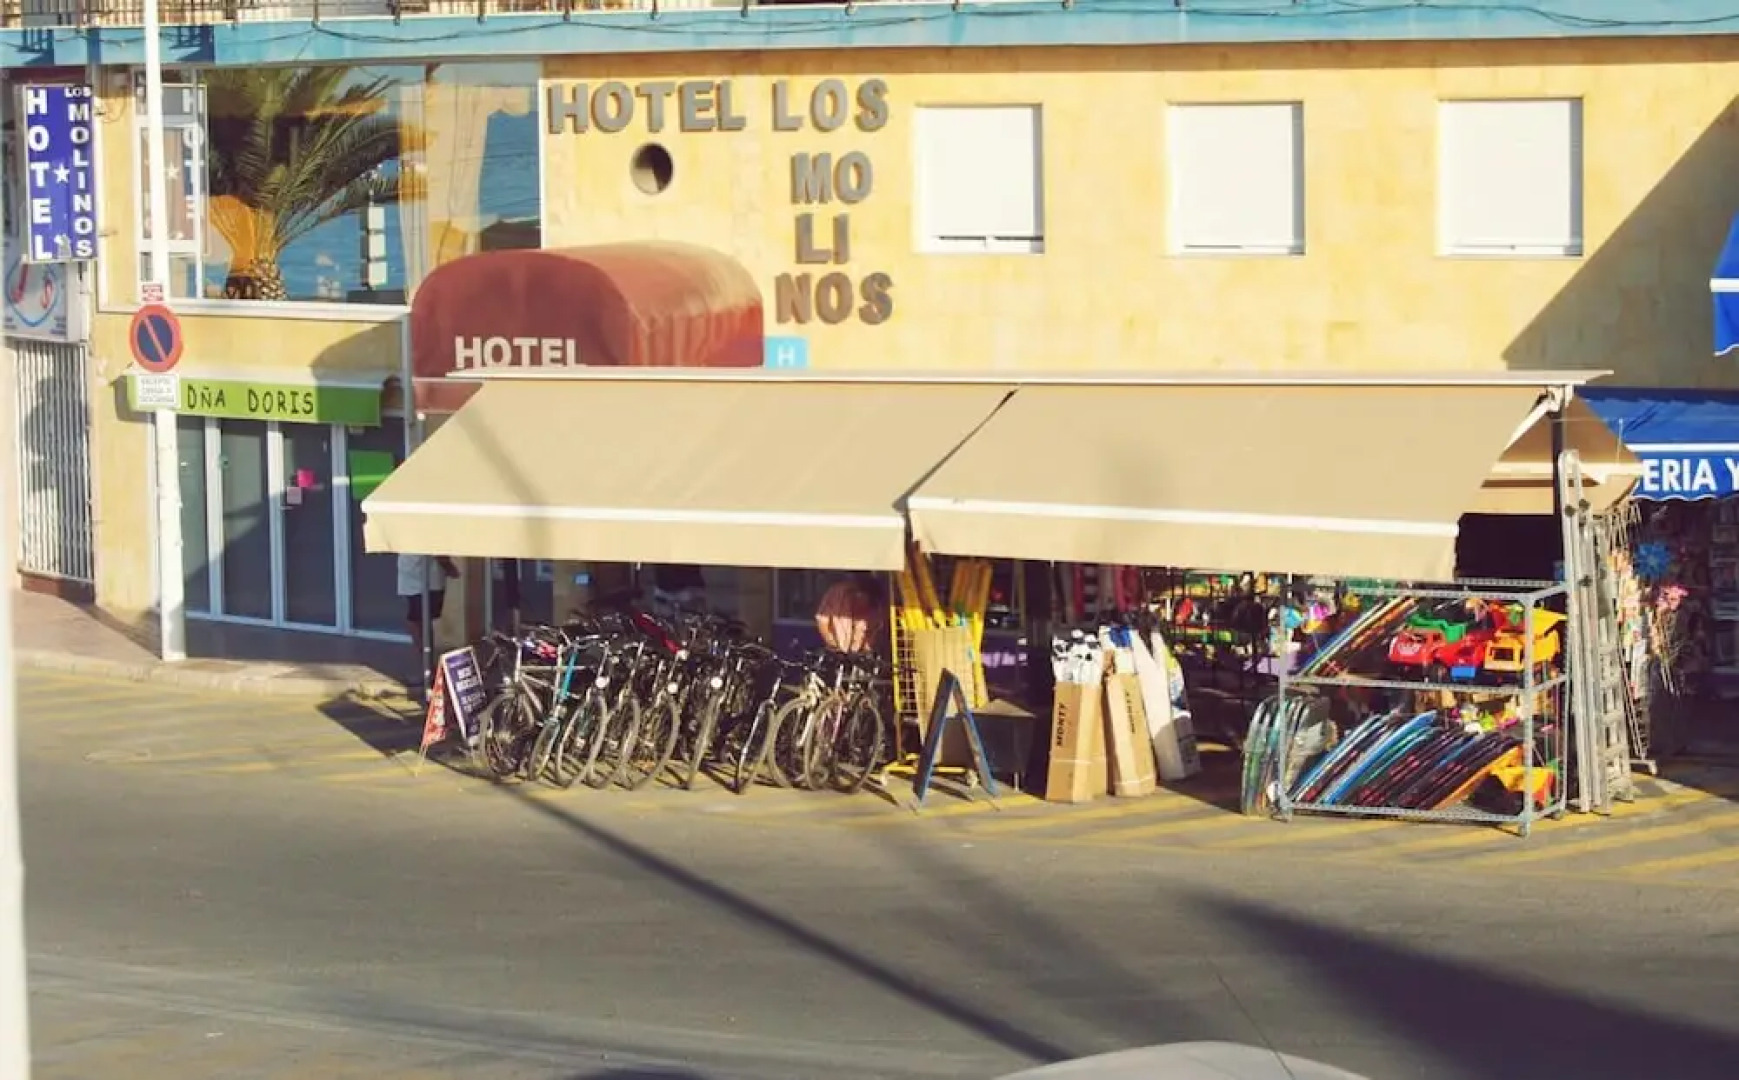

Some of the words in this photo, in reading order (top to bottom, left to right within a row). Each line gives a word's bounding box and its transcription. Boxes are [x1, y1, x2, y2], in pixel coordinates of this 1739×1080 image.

[64, 86, 92, 98] LOS
[547, 80, 747, 134] HOTEL
[772, 79, 890, 132] LOS
[27, 88, 53, 260] HOTEL
[68, 103, 93, 257] MOLINOS
[790, 150, 874, 205] MO
[794, 212, 850, 265] LI
[774, 271, 894, 326] NOS
[454, 335, 587, 369] HOTEL
[778, 344, 796, 368] H
[187, 384, 226, 409] DÑA
[247, 387, 314, 415] DORIS
[1642, 458, 1718, 491] ERIA
